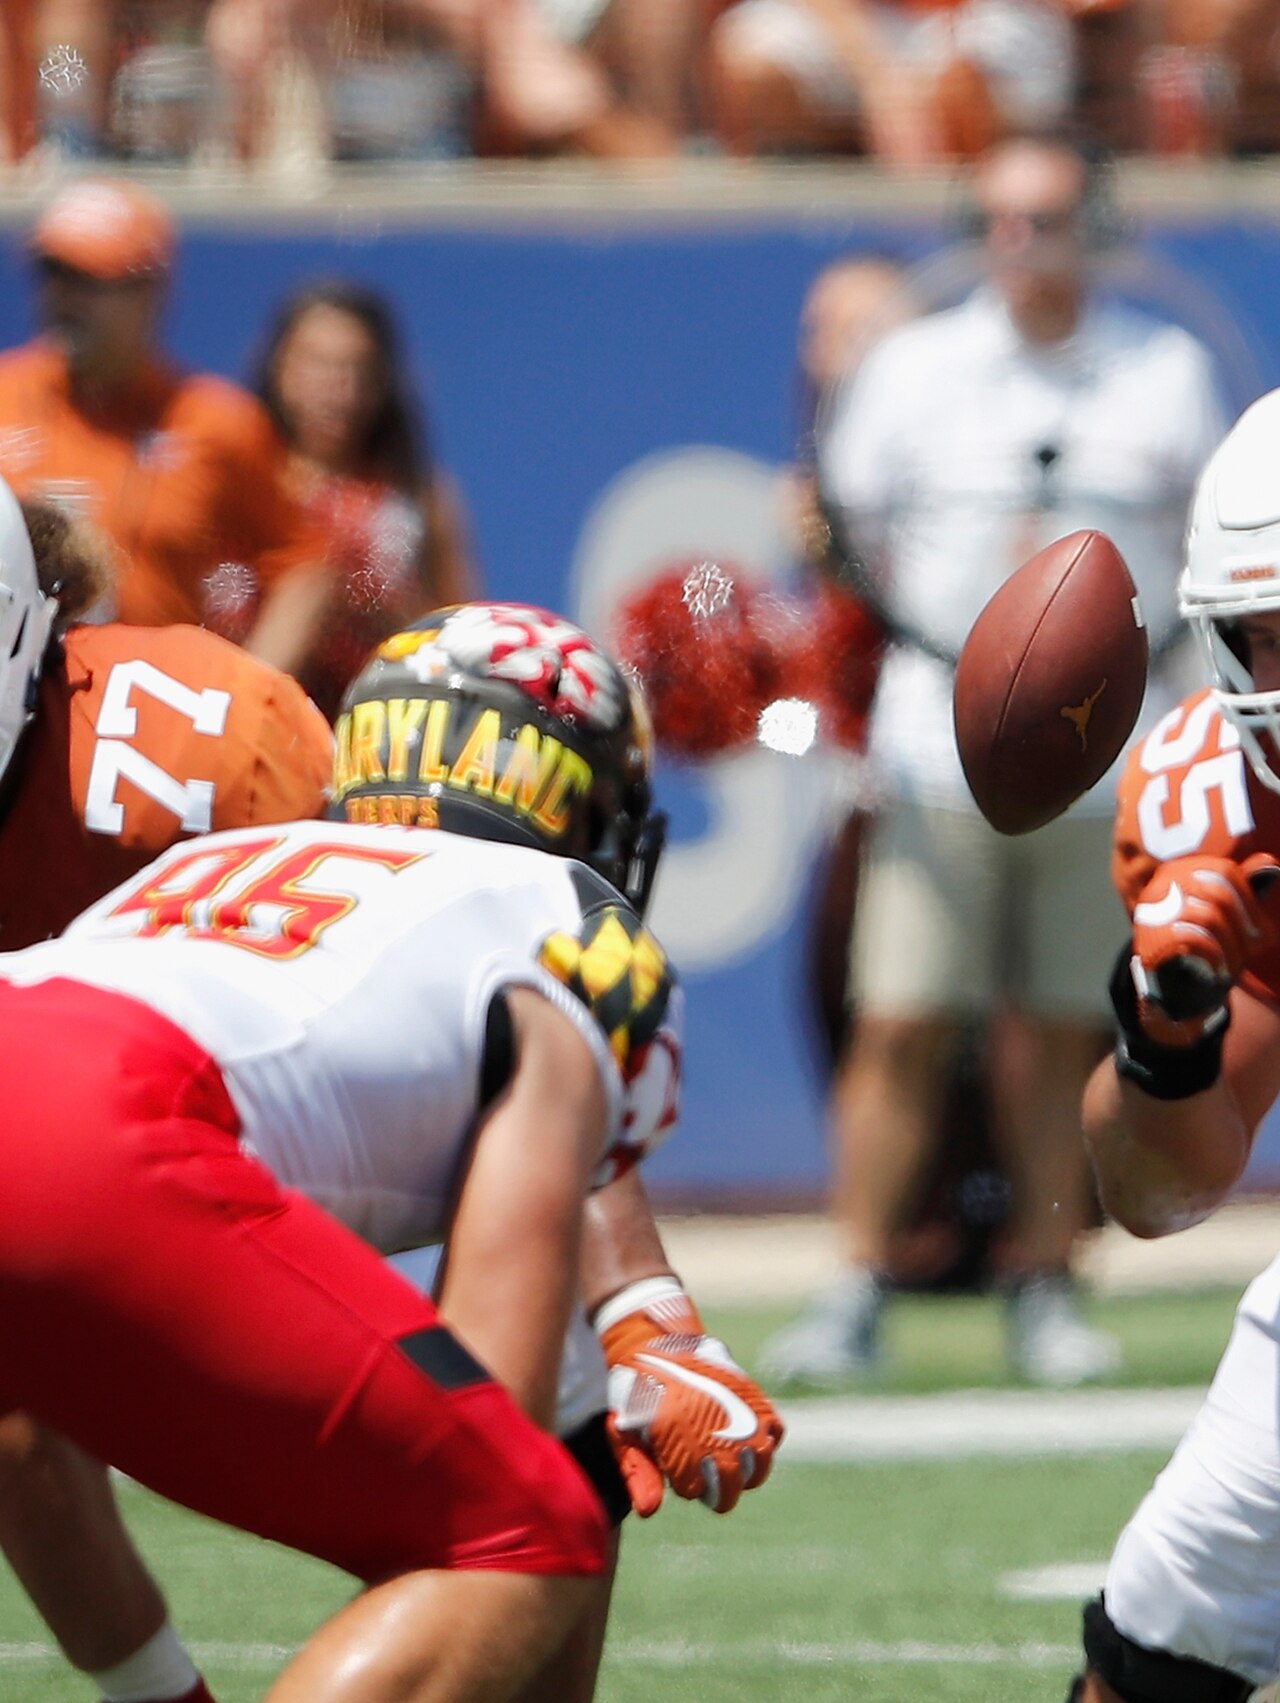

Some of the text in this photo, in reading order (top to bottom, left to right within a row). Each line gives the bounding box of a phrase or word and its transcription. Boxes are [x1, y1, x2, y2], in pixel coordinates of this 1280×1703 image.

[84, 659, 232, 835] 77
[345, 794, 440, 828] TERPS
[1137, 688, 1256, 861] 55
[106, 836, 436, 960] 96
